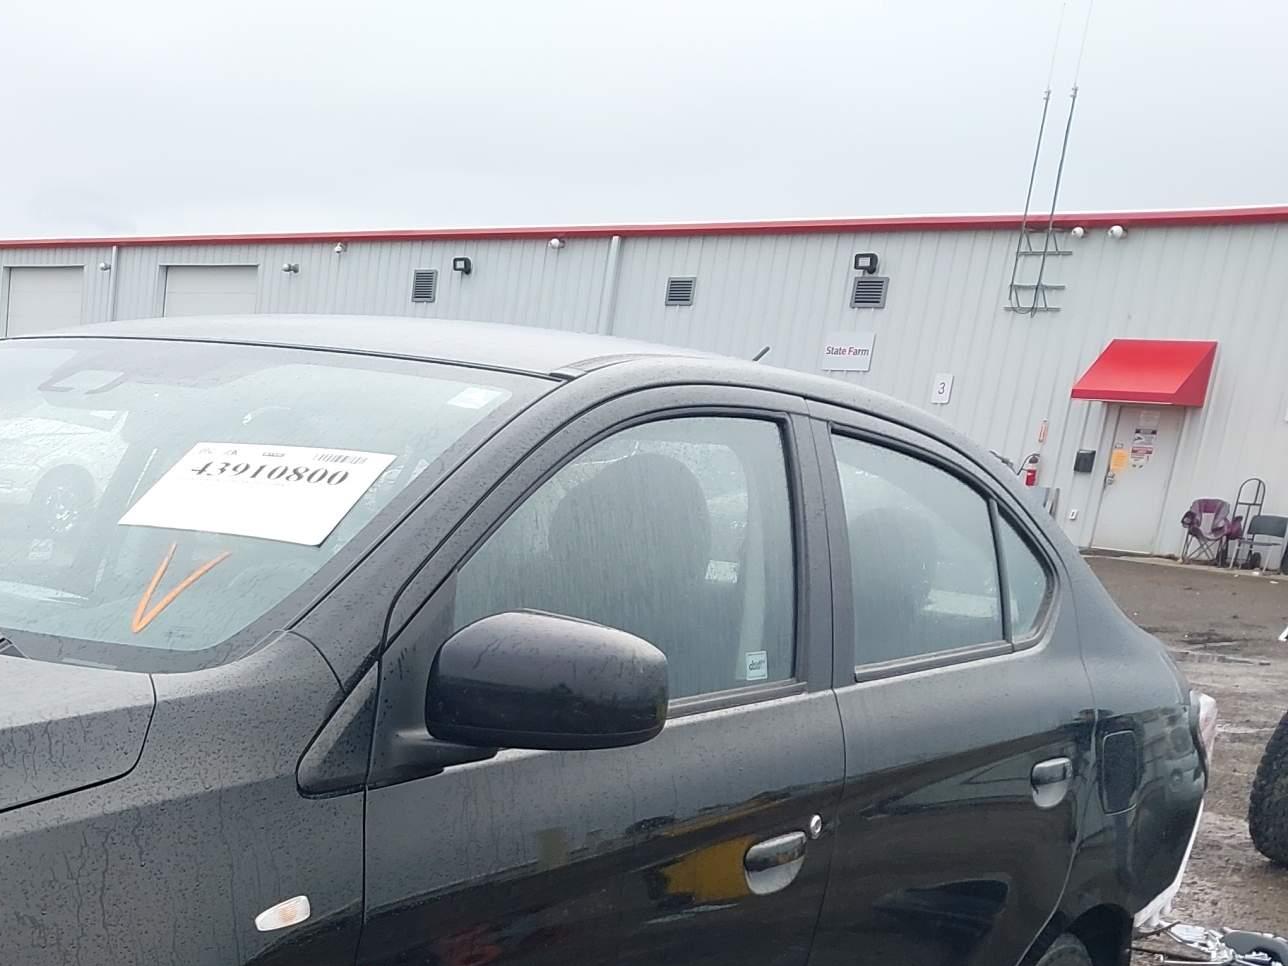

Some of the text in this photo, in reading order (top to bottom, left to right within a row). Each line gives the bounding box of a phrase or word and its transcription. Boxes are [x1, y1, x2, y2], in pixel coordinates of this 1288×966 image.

[826, 346, 869, 356] State Farm
[938, 382, 946, 394] 3
[192, 461, 350, 486] 43910800
